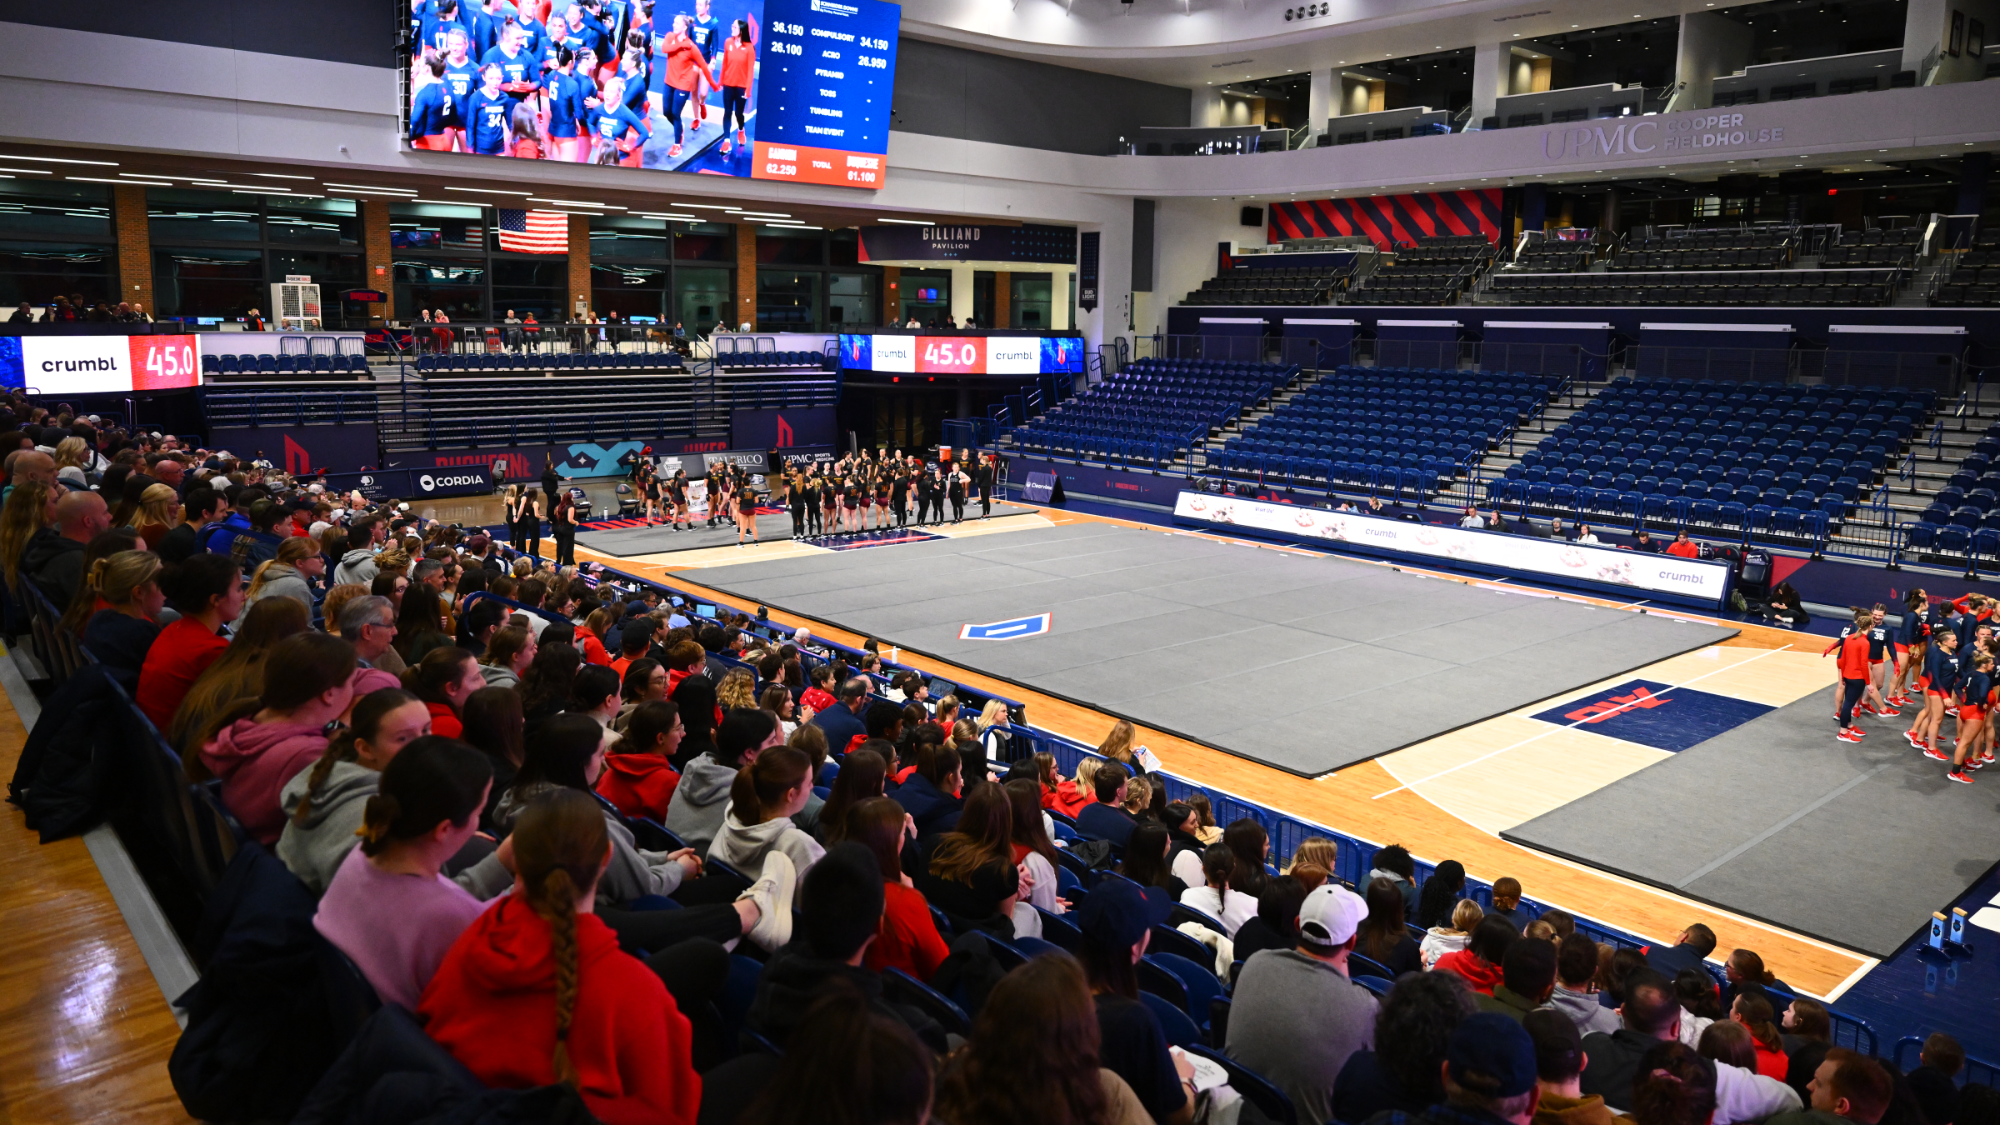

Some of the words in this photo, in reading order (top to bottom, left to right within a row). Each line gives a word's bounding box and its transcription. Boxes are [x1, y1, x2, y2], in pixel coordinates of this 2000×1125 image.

[772, 21, 804, 36] 36.150
[811, 28, 855, 42] COMPULSORY
[771, 41, 802, 56] 26.100
[860, 36, 889, 51] 34.150
[822, 50, 841, 59] ACRO
[858, 55, 887, 69] 26.950
[815, 68, 844, 79] PYRAMID
[452, 81, 467, 95] 30
[819, 88, 837, 98] TOSS
[442, 95, 451, 116] 2
[810, 106, 843, 118] TUMBLING
[1666, 113, 1744, 132] COOPER
[805, 125, 823, 135] TEAM
[823, 127, 845, 137] EVENT
[1543, 122, 1658, 161] UPMC
[1664, 127, 1785, 150] FIELDHOUSE
[766, 163, 797, 176] 62.250
[812, 160, 832, 169] TOTAL
[847, 170, 876, 182] 61.100
[922, 227, 981, 241] GILLIAND
[877, 349, 907, 359] crumbl
[924, 343, 976, 366] 45.0
[995, 351, 1033, 361] crumbl
[41, 357, 118, 373] crumbl
[146, 346, 193, 377] 45.0
[783, 454, 812, 464] UPMC
[436, 474, 484, 487] CORDIA
[1365, 528, 1397, 539] crumbl
[1658, 570, 1704, 585] crumbl
[1874, 632, 1884, 641] 36
